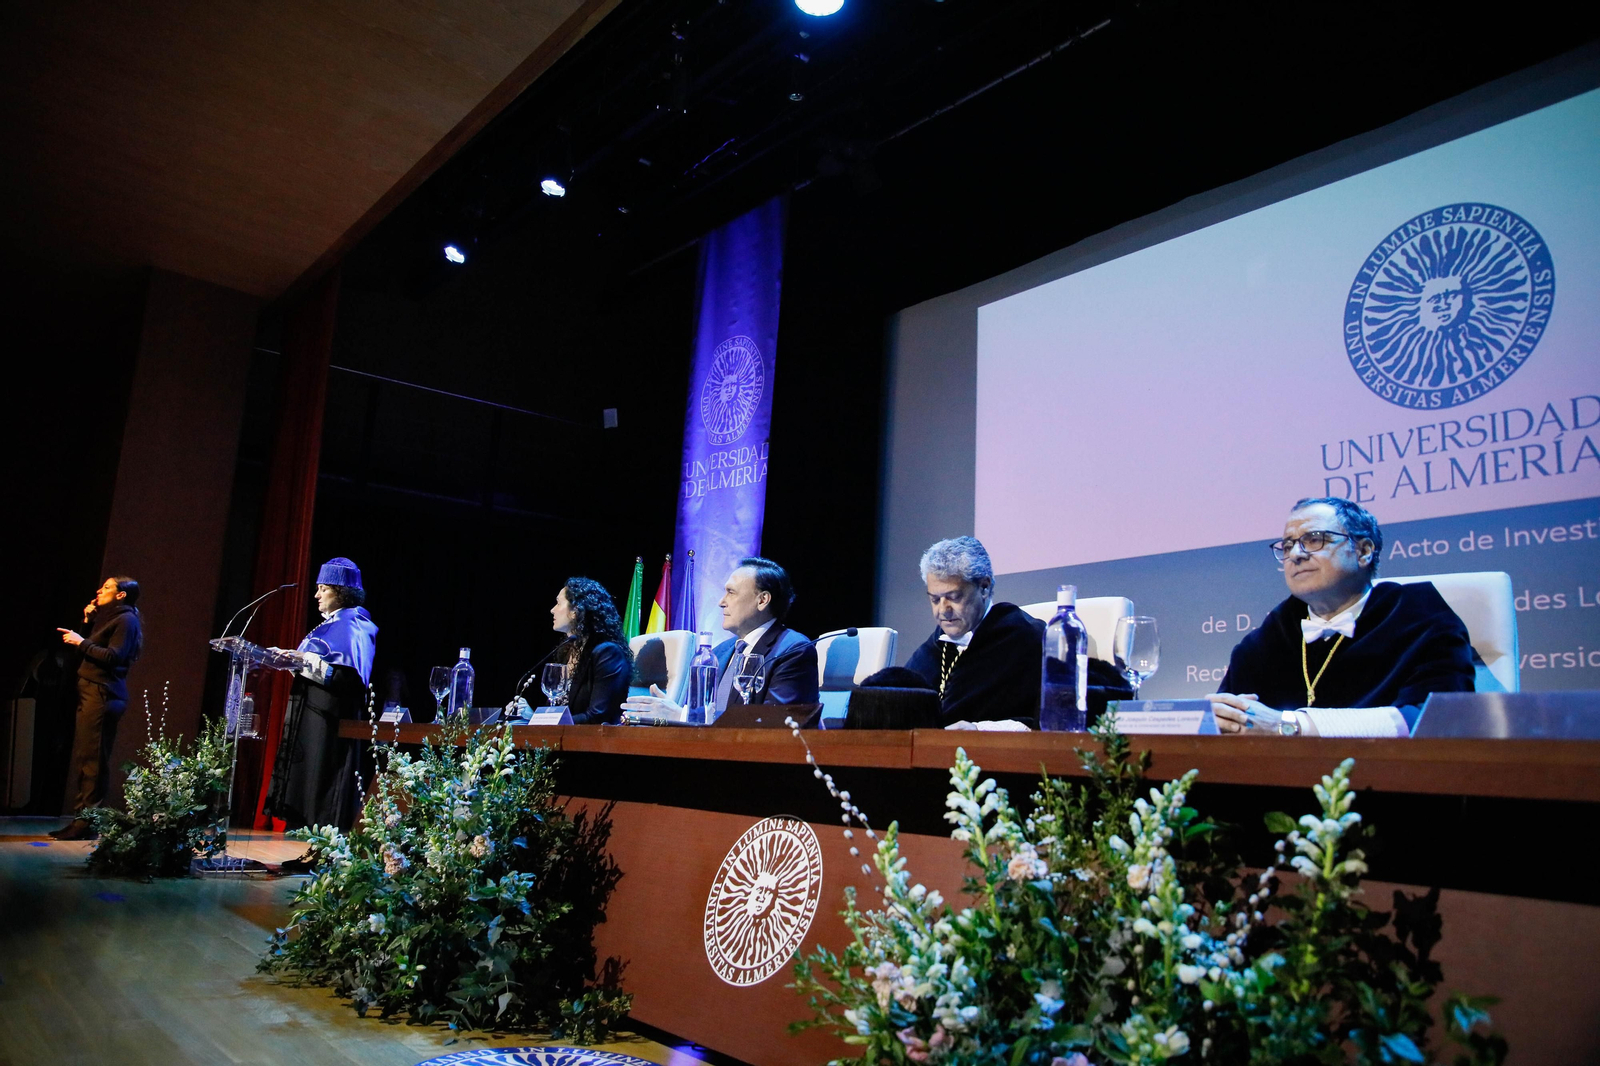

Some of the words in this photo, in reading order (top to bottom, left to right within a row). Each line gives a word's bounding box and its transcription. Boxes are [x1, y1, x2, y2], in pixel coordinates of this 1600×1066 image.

[1350, 281, 1369, 304] IN
[1362, 212, 1436, 278] LUMINE
[1441, 205, 1542, 259] SAPIENTIA
[1345, 322, 1442, 408] UNIVERSITAS
[1451, 268, 1552, 406] ALMERIENSIS
[1320, 394, 1600, 472] UNIVERSIDAD
[1323, 470, 1376, 504] DE
[1390, 432, 1600, 499] ALMERÍA
[1388, 538, 1449, 561] Acto
[1459, 530, 1494, 552] de
[1504, 517, 1600, 548] Invest
[1201, 615, 1228, 634] de
[1236, 613, 1257, 632] D.
[723, 852, 737, 872] IN
[738, 818, 785, 850] LUMINE
[786, 819, 821, 883] SAPIENTIA
[706, 882, 735, 982] UNIVERSITAS
[736, 898, 816, 984] ALMERIENSIS
[556, 1047, 652, 1066] LUMINE
